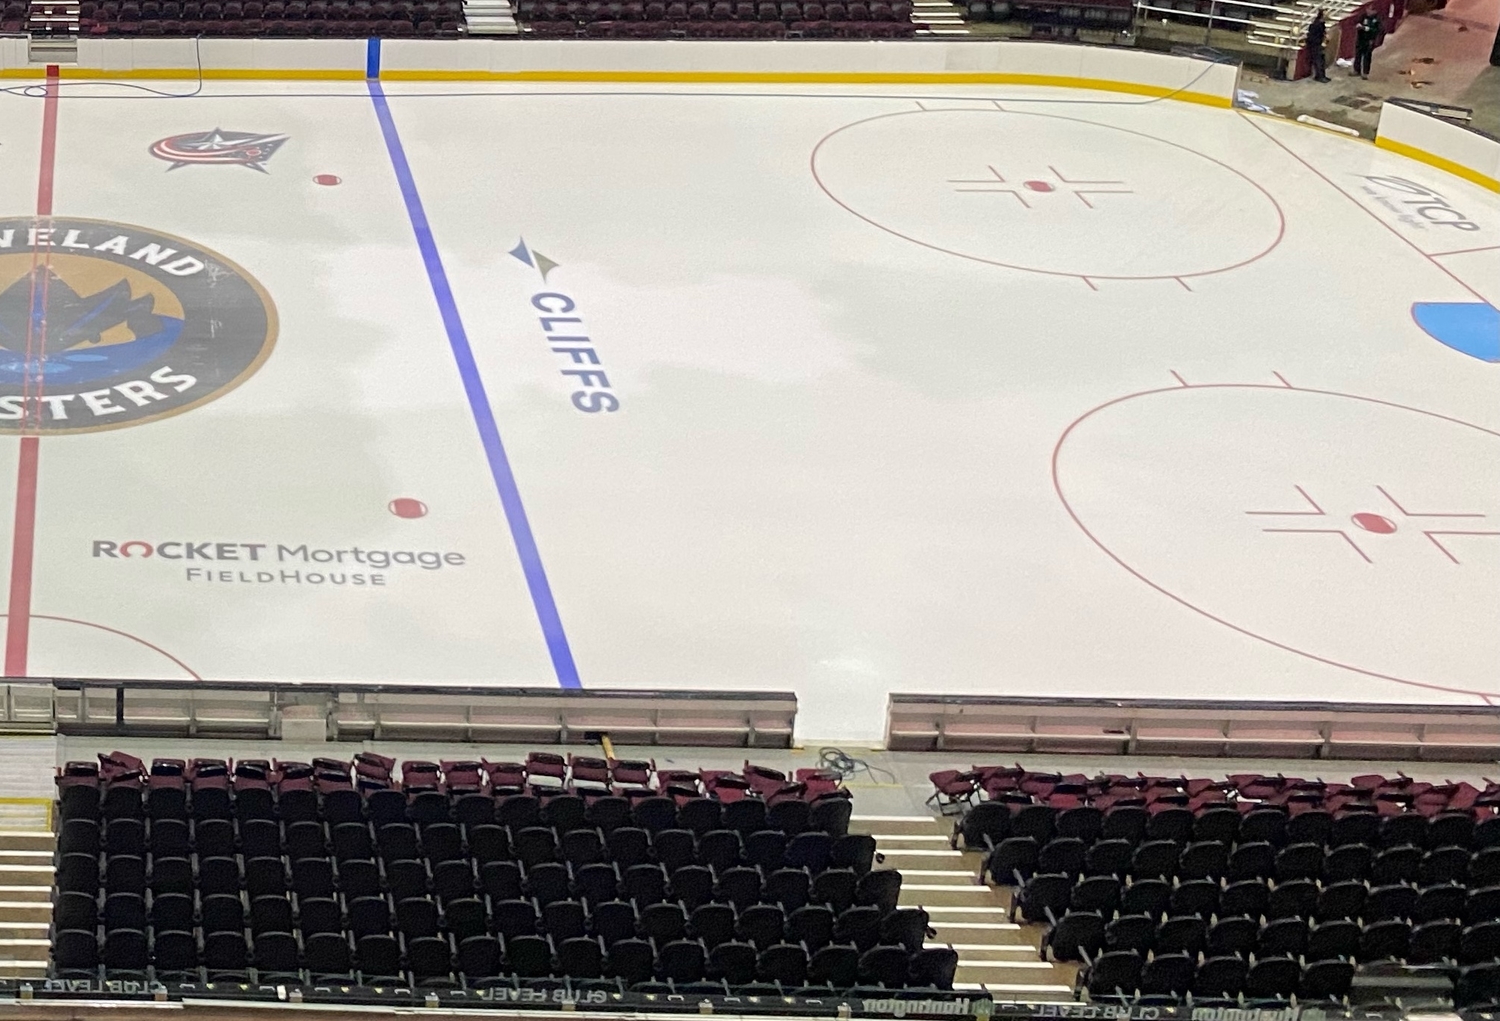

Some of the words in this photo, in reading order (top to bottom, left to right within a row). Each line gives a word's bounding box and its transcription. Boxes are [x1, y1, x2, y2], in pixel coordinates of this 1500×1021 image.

[1402, 197, 1481, 231] TCP
[530, 292, 620, 413] CLIFFS
[91, 539, 266, 562] ROCKET
[277, 543, 466, 570] Mortgage
